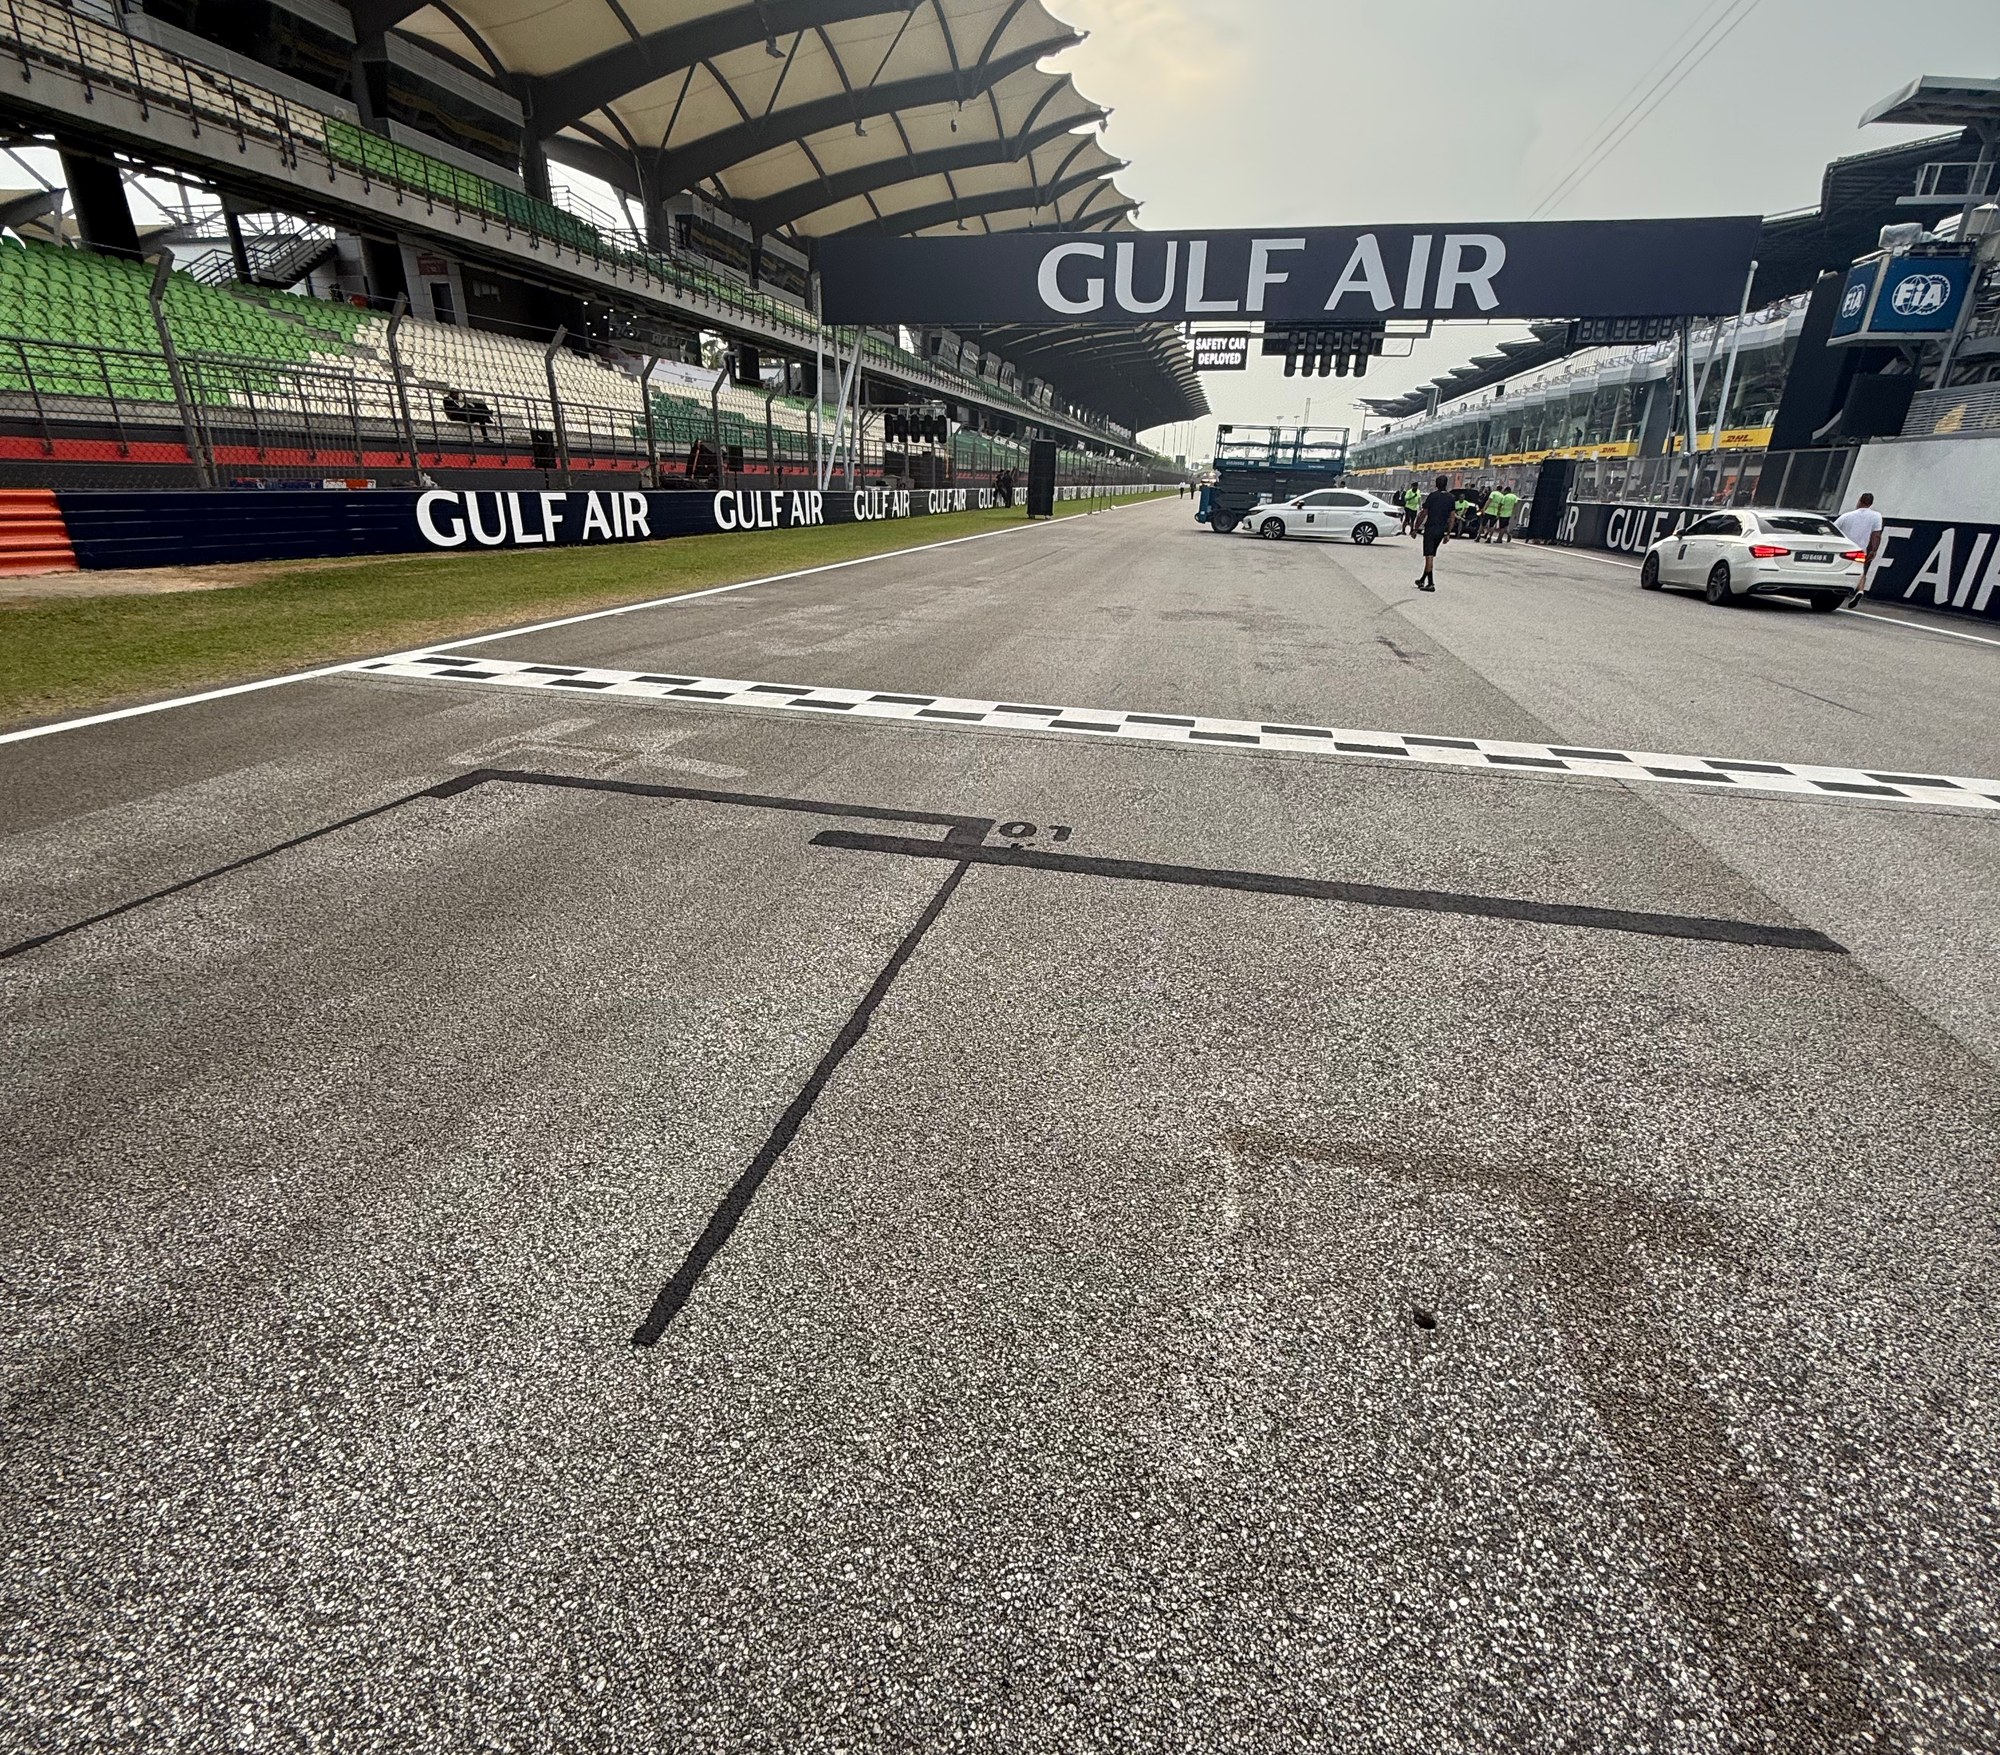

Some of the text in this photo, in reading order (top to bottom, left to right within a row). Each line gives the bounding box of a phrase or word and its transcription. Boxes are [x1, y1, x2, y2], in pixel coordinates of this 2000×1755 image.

[1037, 233, 1506, 314] GULF AIR
[1196, 337, 1245, 350] SAFETY CAR
[1199, 353, 1241, 364] DEPLOYED
[1726, 434, 1749, 443] DHL
[713, 490, 824, 530] GULF AIR
[853, 490, 910, 521] GULF AIR
[928, 488, 967, 514] GULF AIR
[978, 488, 995, 509] GULF
[416, 490, 651, 547] GULF AIR
[1606, 507, 1669, 553] GULF
[999, 821, 1073, 842] 01
